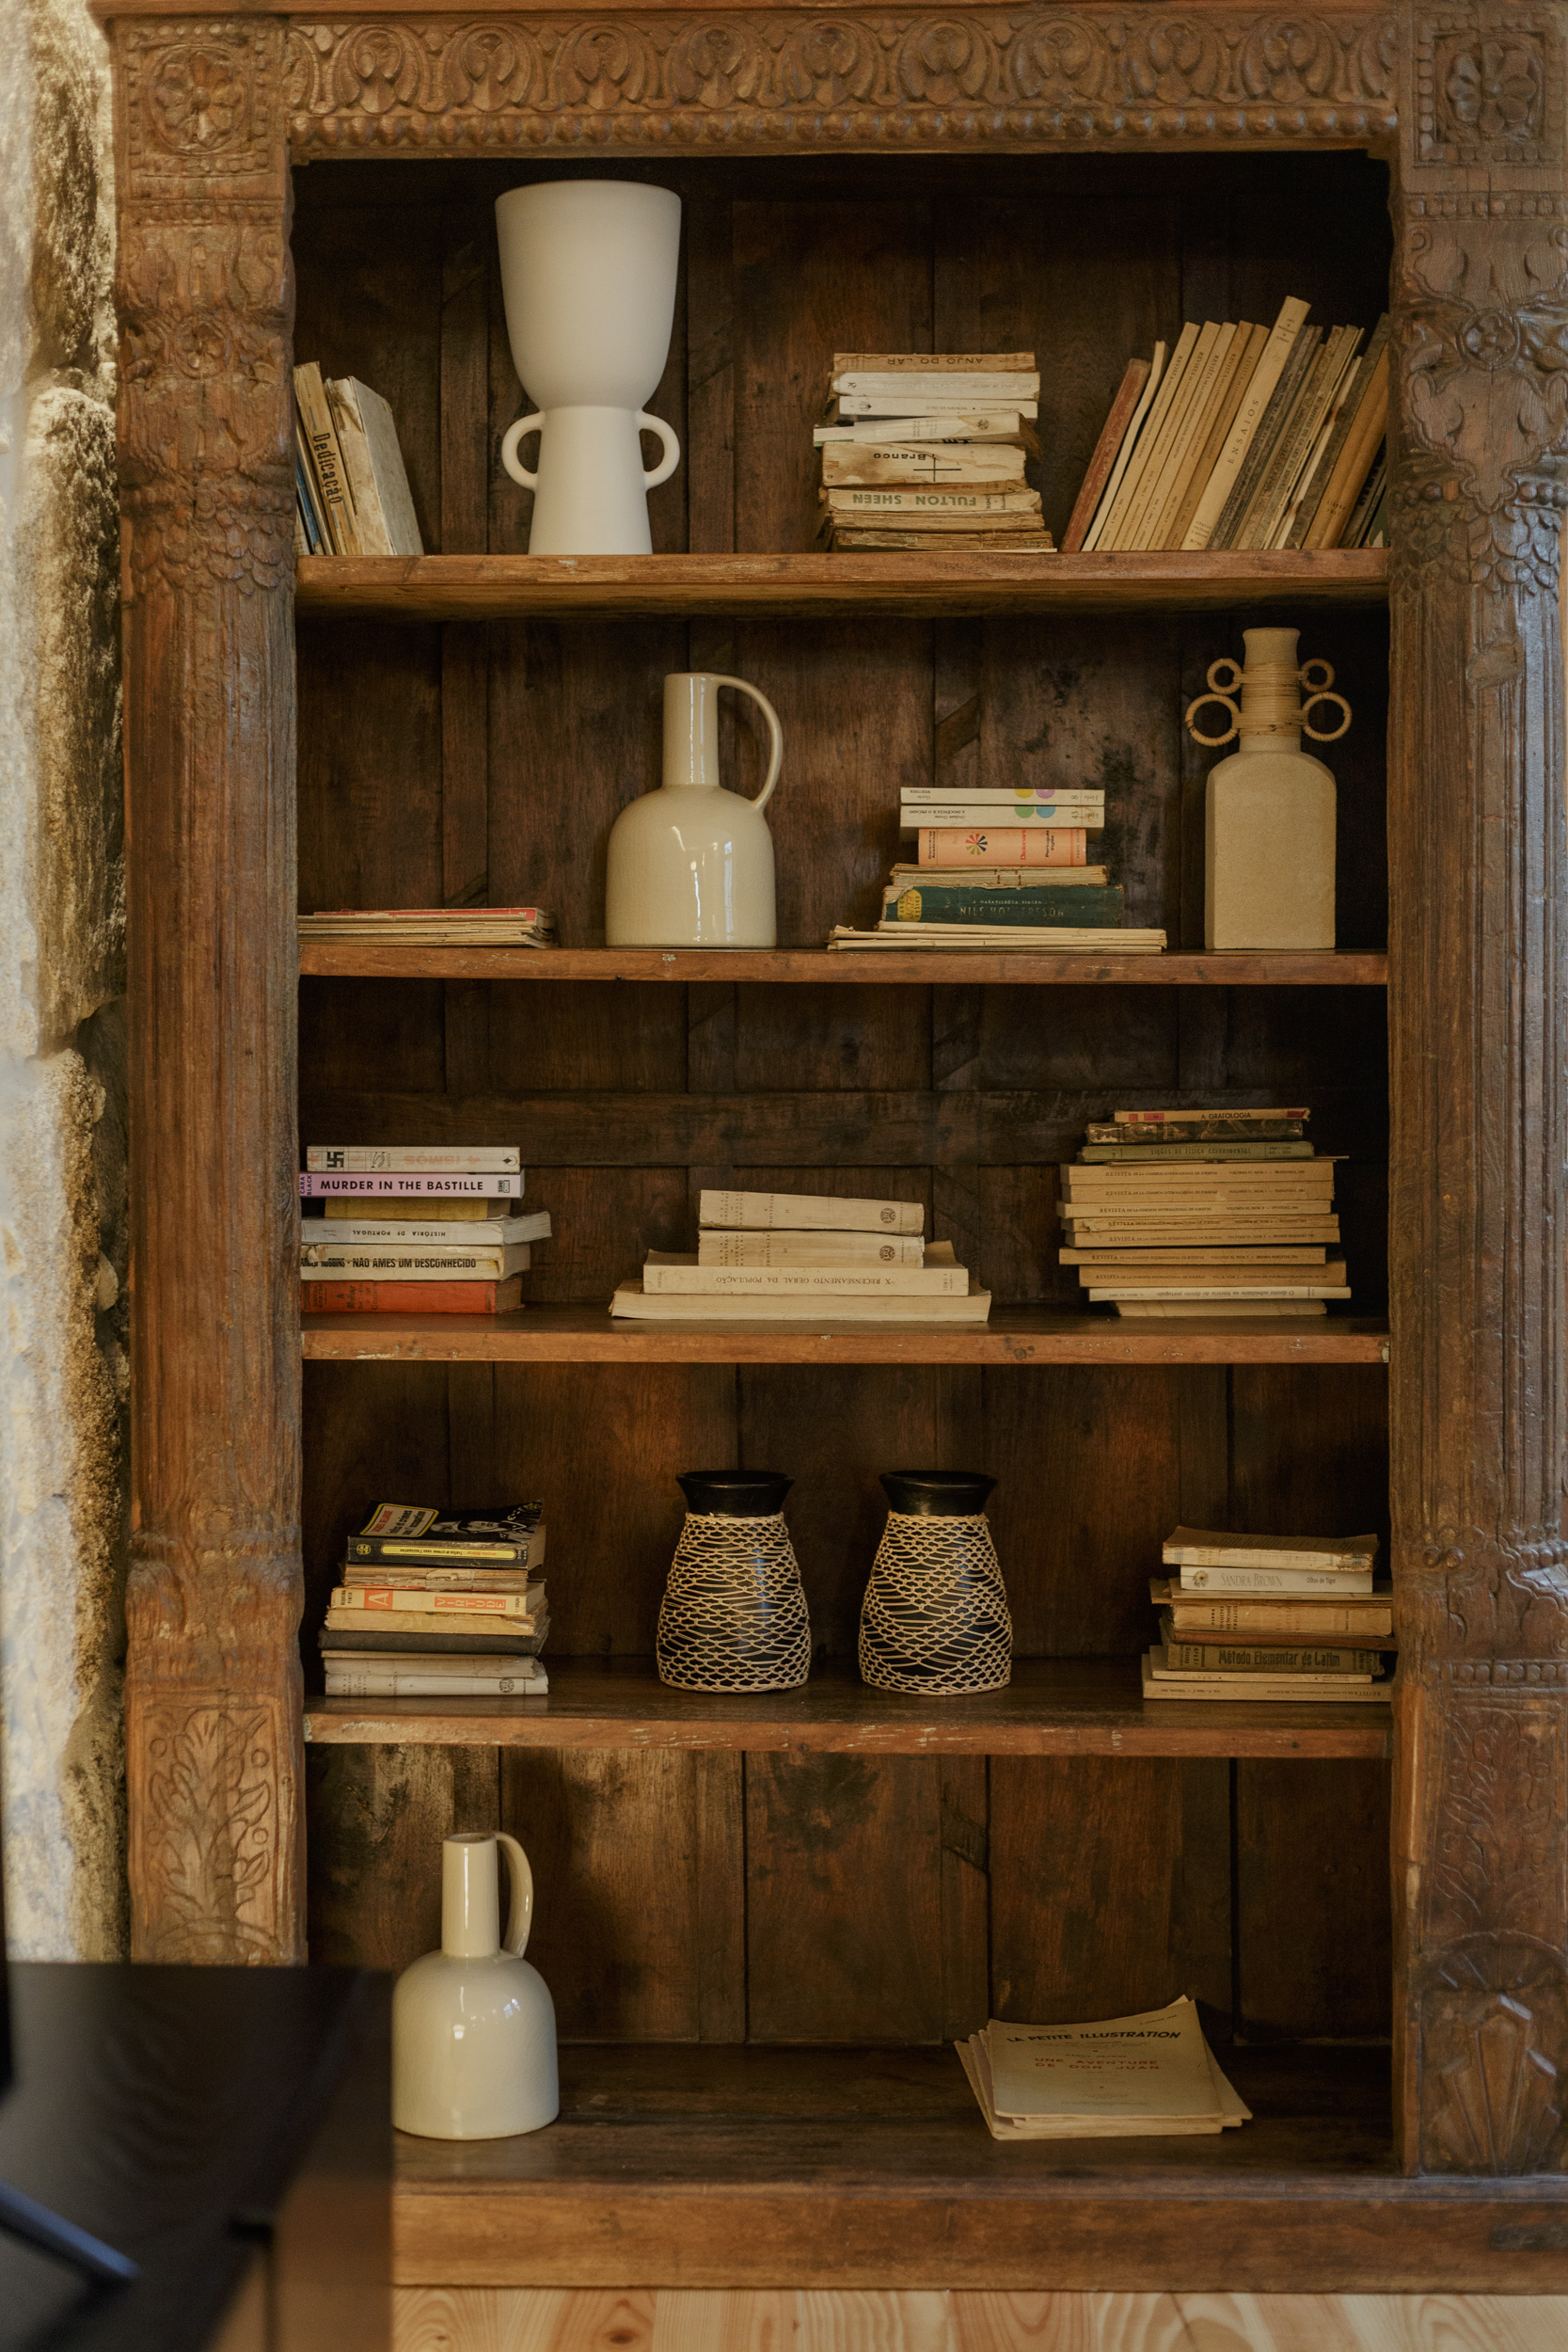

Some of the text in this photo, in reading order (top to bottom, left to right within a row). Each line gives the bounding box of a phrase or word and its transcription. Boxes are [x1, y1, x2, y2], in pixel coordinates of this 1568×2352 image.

[1227, 399, 1259, 465] ENSAIOS
[312, 432, 343, 504] Dedicação
[852, 494, 976, 506] FULTON SHEEN
[959, 906, 1065, 917] NILS HOERSSON
[404, 1154, 461, 1166] ISMOS
[320, 1180, 483, 1191] MURDER IN THE BASTILLE
[353, 1257, 370, 1268] NÃO
[372, 1257, 396, 1268] AMES
[399, 1258, 413, 1268] UM
[415, 1258, 476, 1268] DESCONHECIDO
[716, 1276, 762, 1284] POPULAÇÃO
[1221, 1572, 1283, 1587] SANDRA BROWN
[368, 1592, 389, 1607] A
[436, 1597, 505, 1609] VIRTUDE
[1218, 1649, 1251, 1664] Método
[1254, 1651, 1298, 1665] Elementar
[1302, 1652, 1312, 1665] de
[1314, 1652, 1340, 1667] Latim
[1081, 2031, 1181, 2040] ILLUSTRATION
